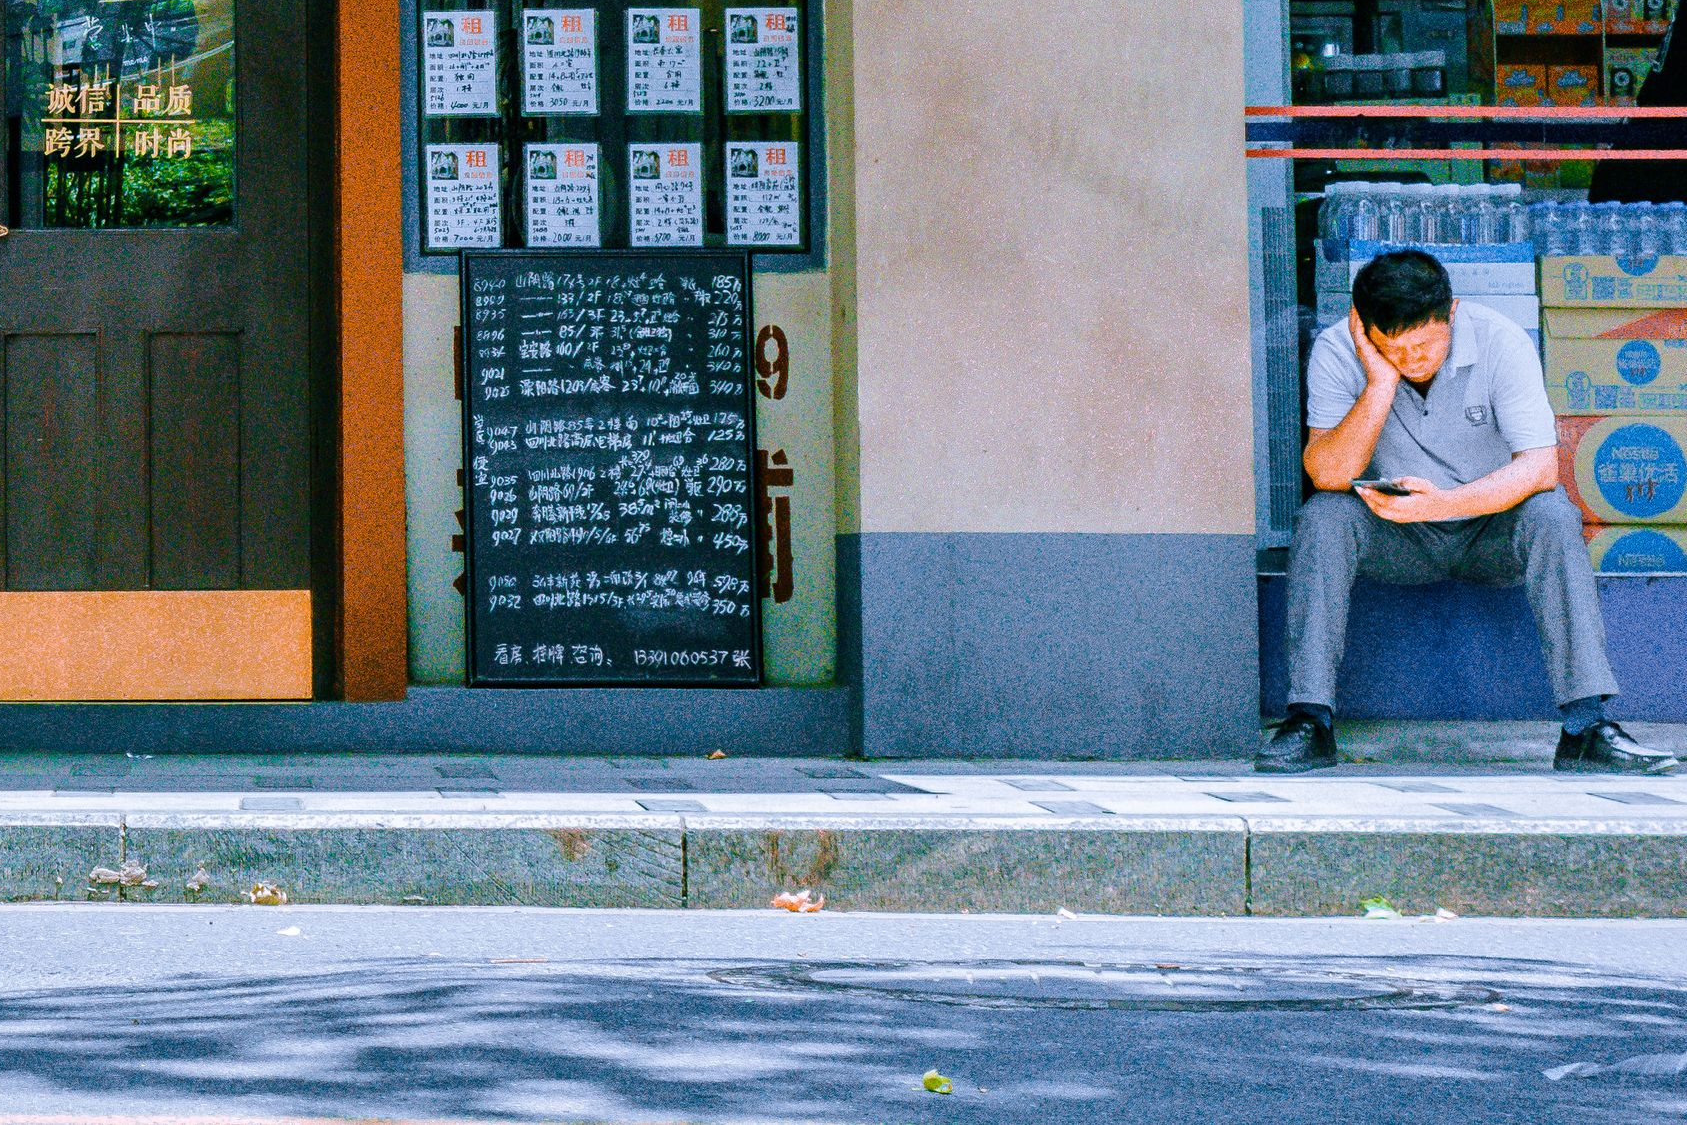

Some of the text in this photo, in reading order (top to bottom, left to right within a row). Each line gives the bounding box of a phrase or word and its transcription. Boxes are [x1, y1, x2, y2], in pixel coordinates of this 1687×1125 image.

[463, 16, 482, 34] 租
[562, 15, 583, 32] 租
[668, 14, 689, 31] 租
[766, 13, 786, 31] 租
[44, 83, 192, 116] 诚信 品质
[44, 127, 192, 160] 跨界 时尚
[466, 150, 487, 167] 租
[564, 149, 585, 166] 租
[668, 149, 689, 166] 租
[766, 148, 787, 165] 租
